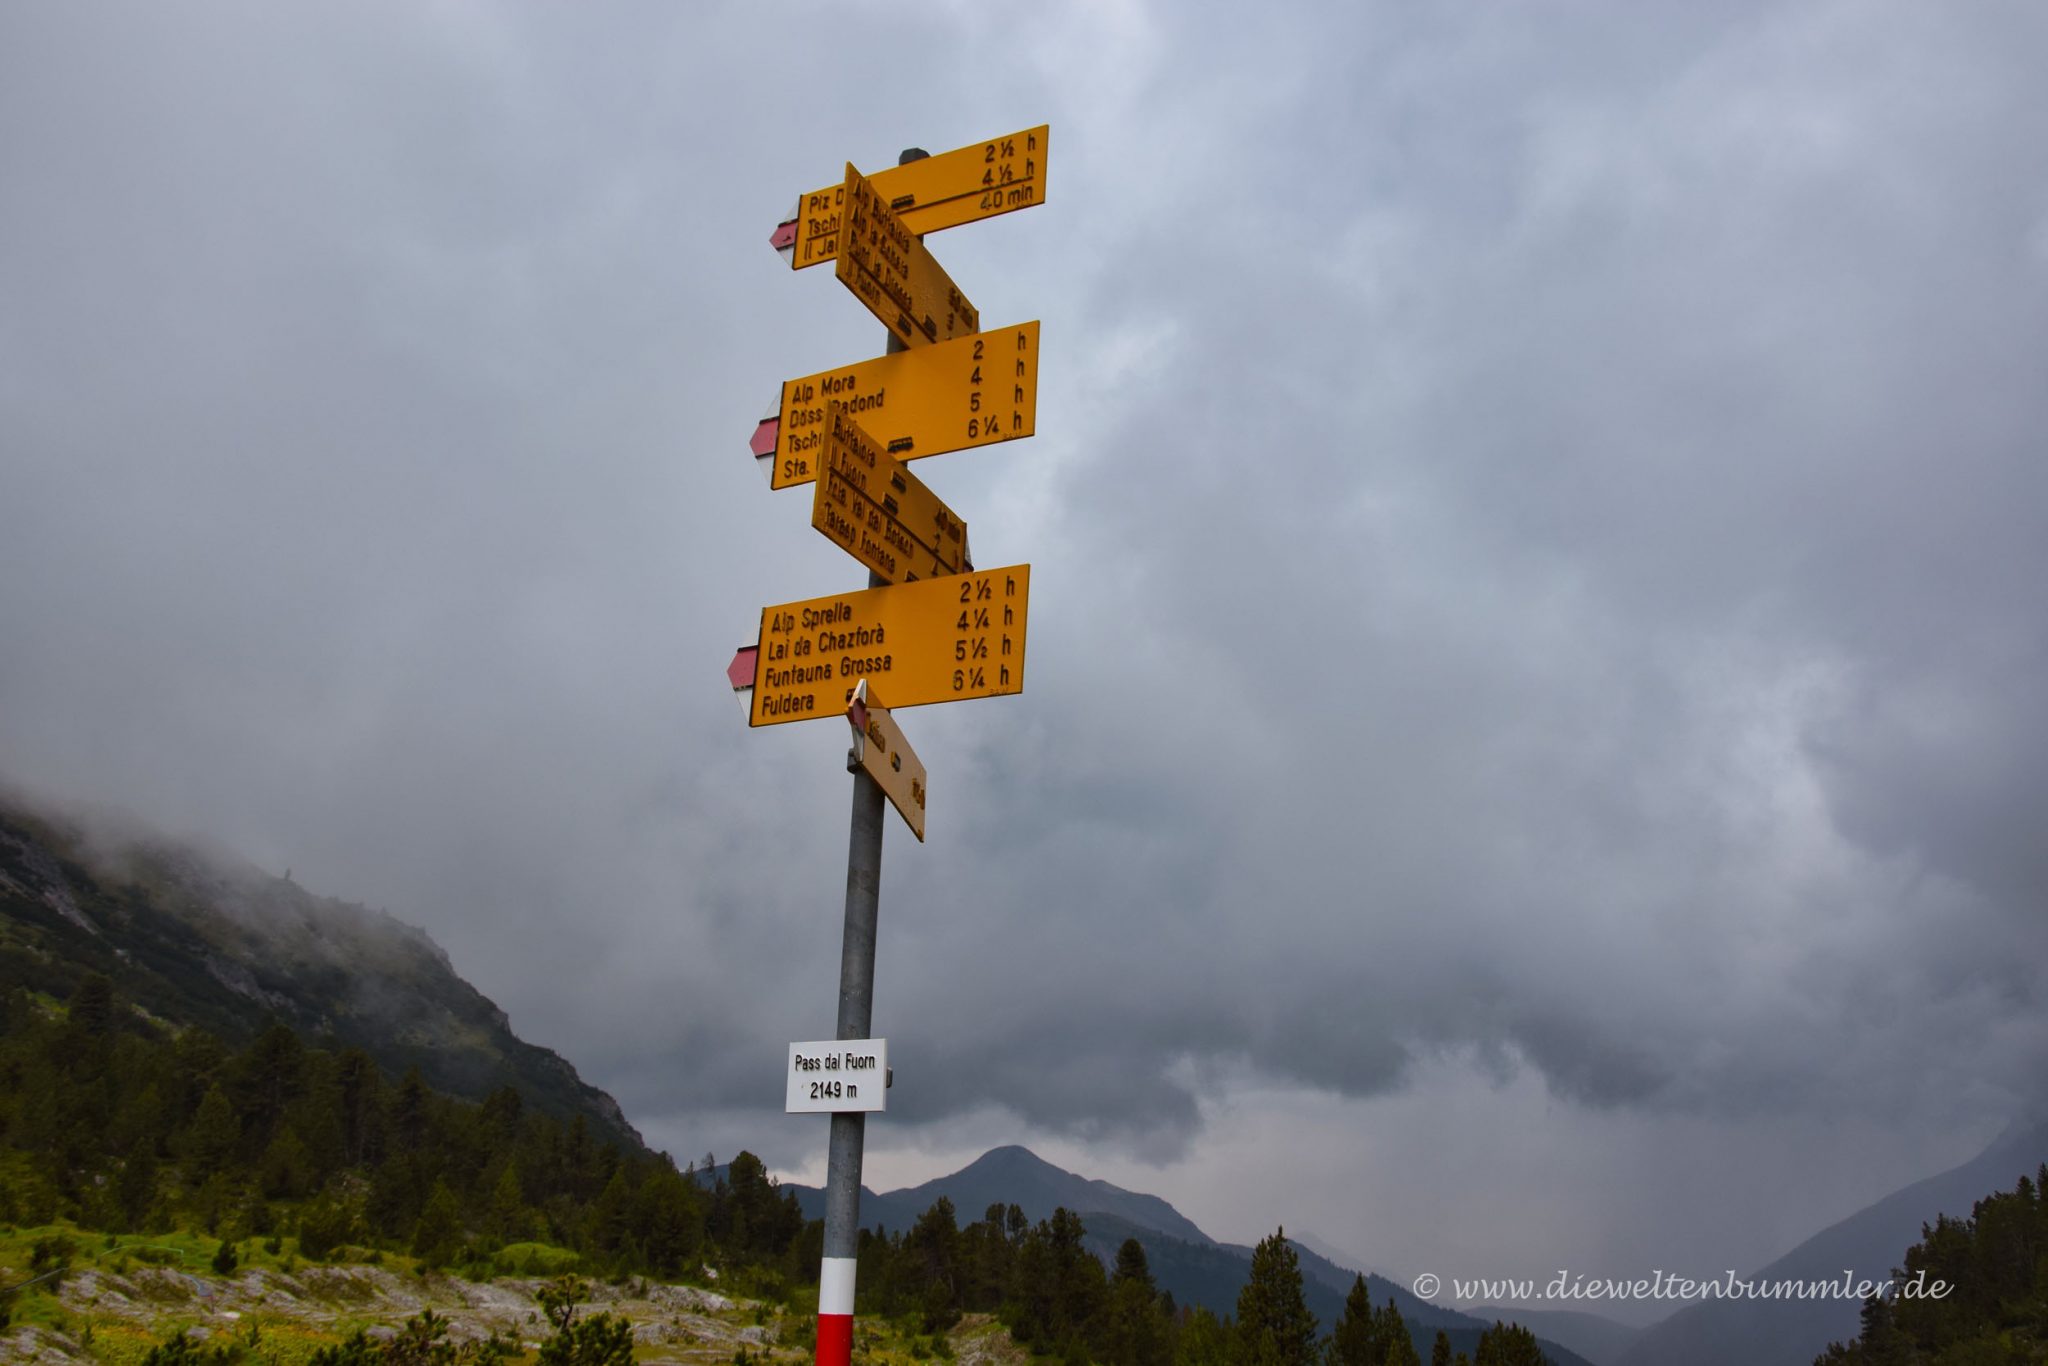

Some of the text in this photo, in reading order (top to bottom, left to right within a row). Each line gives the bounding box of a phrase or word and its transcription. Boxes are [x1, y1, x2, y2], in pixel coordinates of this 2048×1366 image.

[808, 211, 842, 236] Tschi
[982, 168, 994, 185] 4
[1026, 158, 1034, 176] h
[809, 195, 830, 214] Piz
[985, 144, 996, 164] 2
[1027, 133, 1036, 152] h
[980, 190, 1003, 210] 40
[1008, 184, 1033, 206] min
[789, 407, 824, 429] Döss
[970, 366, 982, 386] 4
[1016, 358, 1024, 377] h
[792, 330, 1026, 405] Alp Mora 2 h
[970, 392, 981, 412] 5
[1014, 383, 1023, 403] h
[784, 458, 810, 479] Sta.
[968, 418, 979, 438] 6
[1013, 410, 1022, 430] h
[832, 413, 876, 468] Buffalora
[840, 451, 867, 492] Fuorn
[860, 528, 896, 574] Fontana
[771, 612, 795, 634] Alp
[801, 602, 851, 632] Sprella
[960, 581, 972, 602] 2
[1006, 575, 1015, 596] h
[767, 640, 789, 661] Lai
[794, 635, 810, 657] da
[818, 623, 885, 651] Chazforà
[957, 610, 970, 631] 4
[1004, 604, 1013, 626] h
[764, 662, 832, 688] Funtauna
[840, 653, 892, 677] Grossa
[955, 640, 967, 661] 5
[1002, 633, 1011, 655] h
[761, 692, 814, 717] Fuldera
[953, 669, 964, 691] 6
[1000, 664, 1009, 686] h
[795, 1053, 876, 1071] Pass dal Fuorn
[810, 1081, 857, 1099] 2149 m
